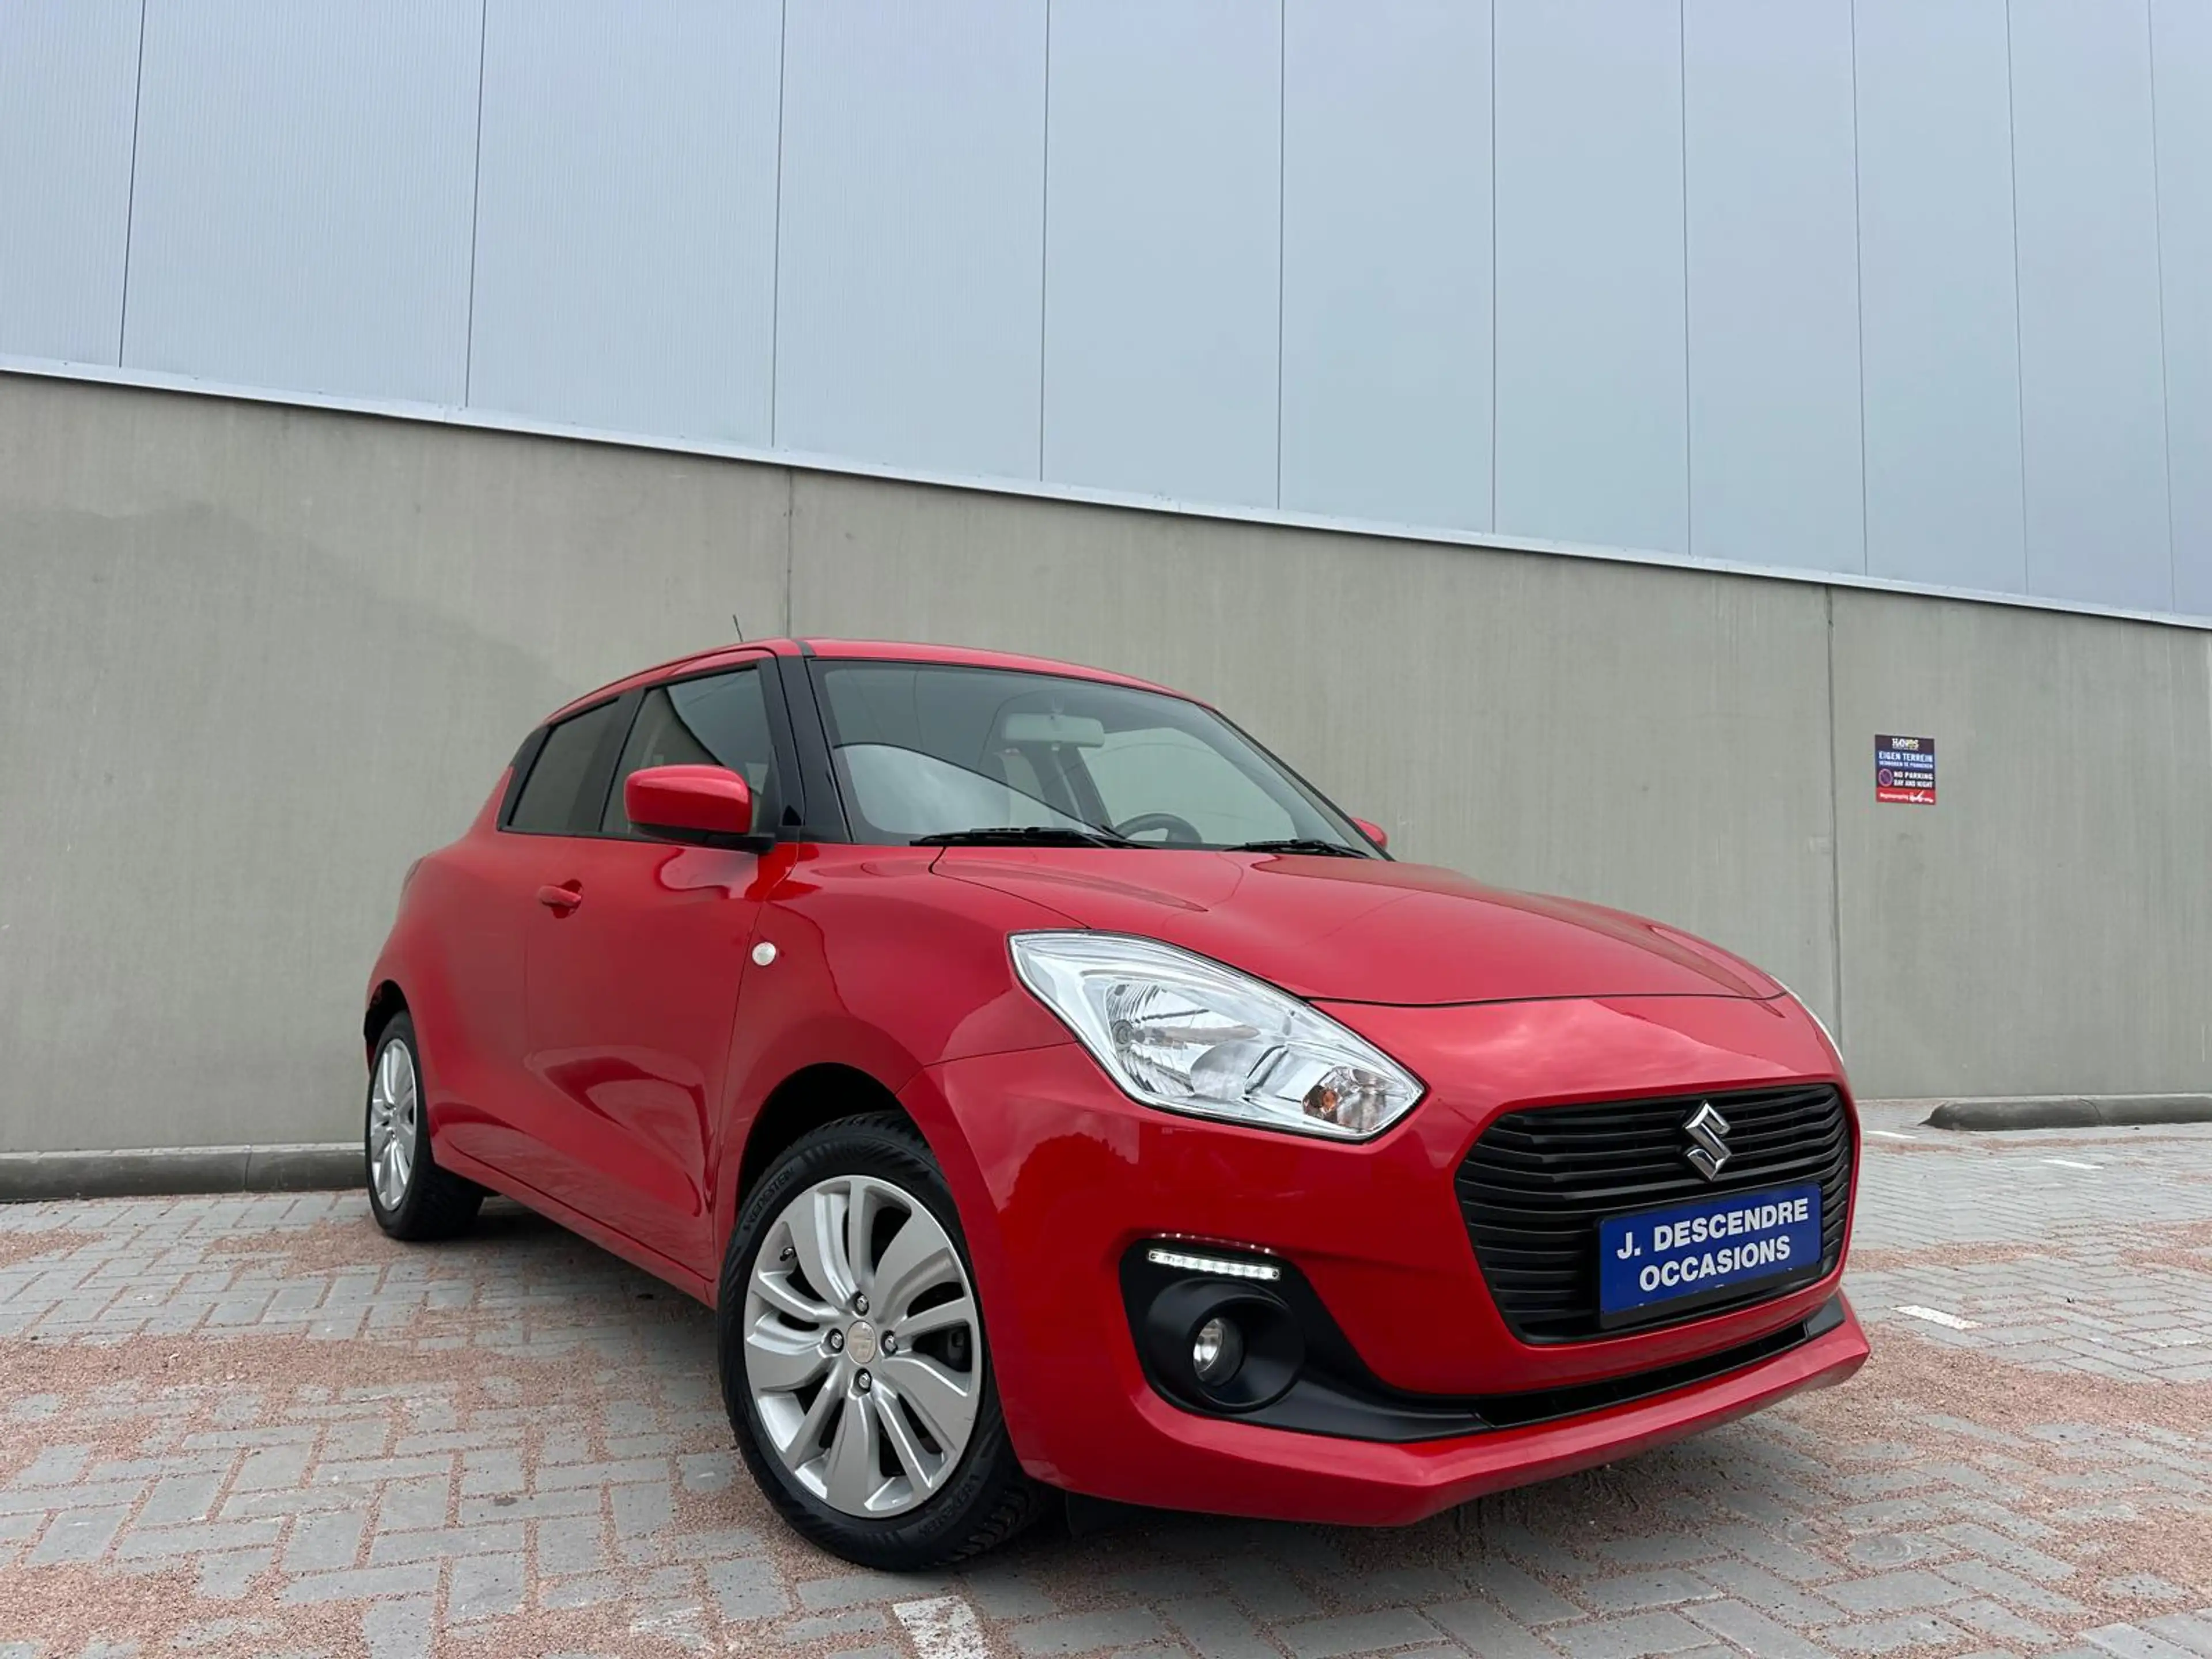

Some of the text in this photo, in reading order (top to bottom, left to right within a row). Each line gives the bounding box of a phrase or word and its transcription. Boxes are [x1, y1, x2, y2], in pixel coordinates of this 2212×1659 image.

[1616, 1198, 1809, 1260] J. DESCENDRE
[1639, 1235, 1791, 1292] OCCASIONS
